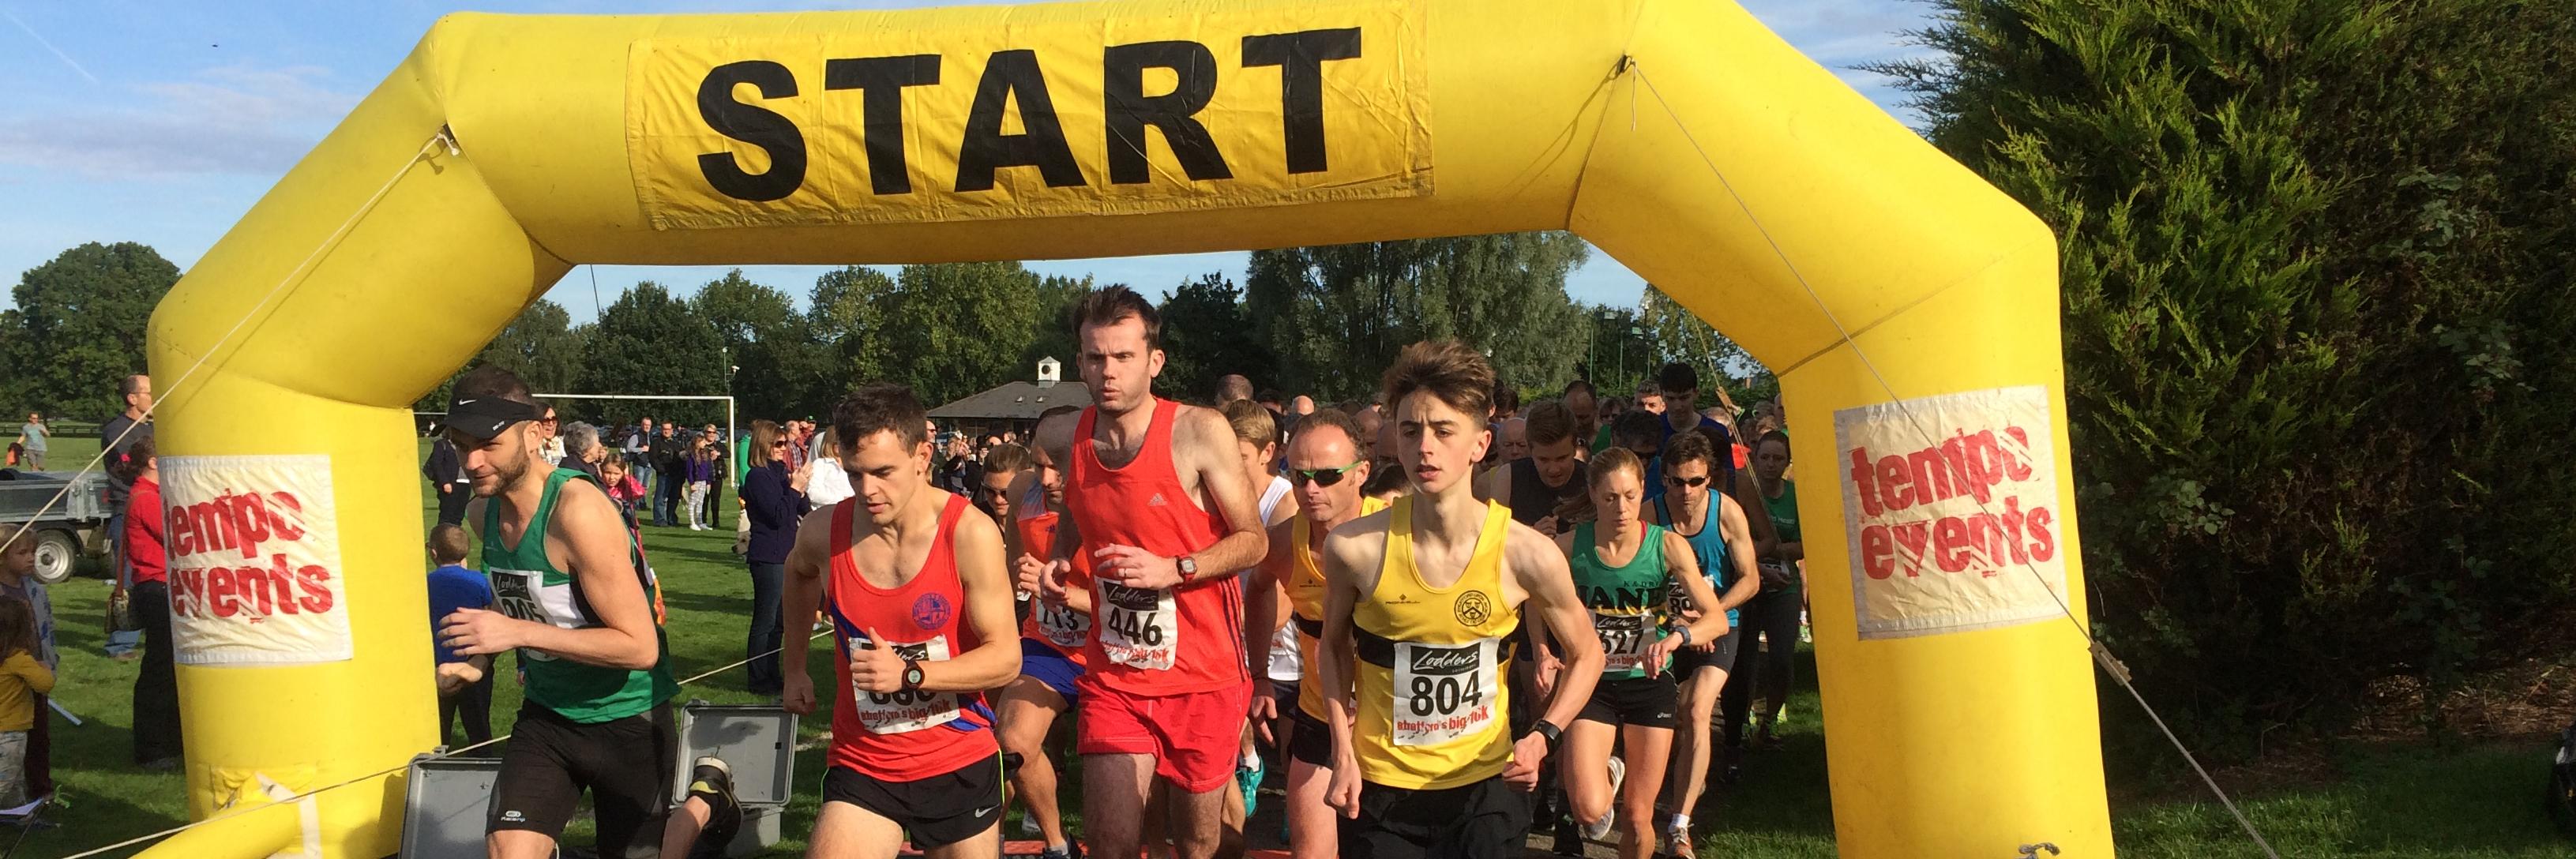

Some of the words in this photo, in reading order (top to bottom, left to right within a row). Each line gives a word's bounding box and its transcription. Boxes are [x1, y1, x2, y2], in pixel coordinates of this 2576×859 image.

[697, 27, 1361, 202] START
[1850, 426, 2033, 517] tempo
[1861, 496, 2053, 580] events
[169, 553, 332, 617] events
[1108, 586, 1157, 604] Lodders
[1109, 607, 1163, 646] 446
[1413, 651, 1478, 670] Lodders
[1410, 670, 1482, 716] 804
